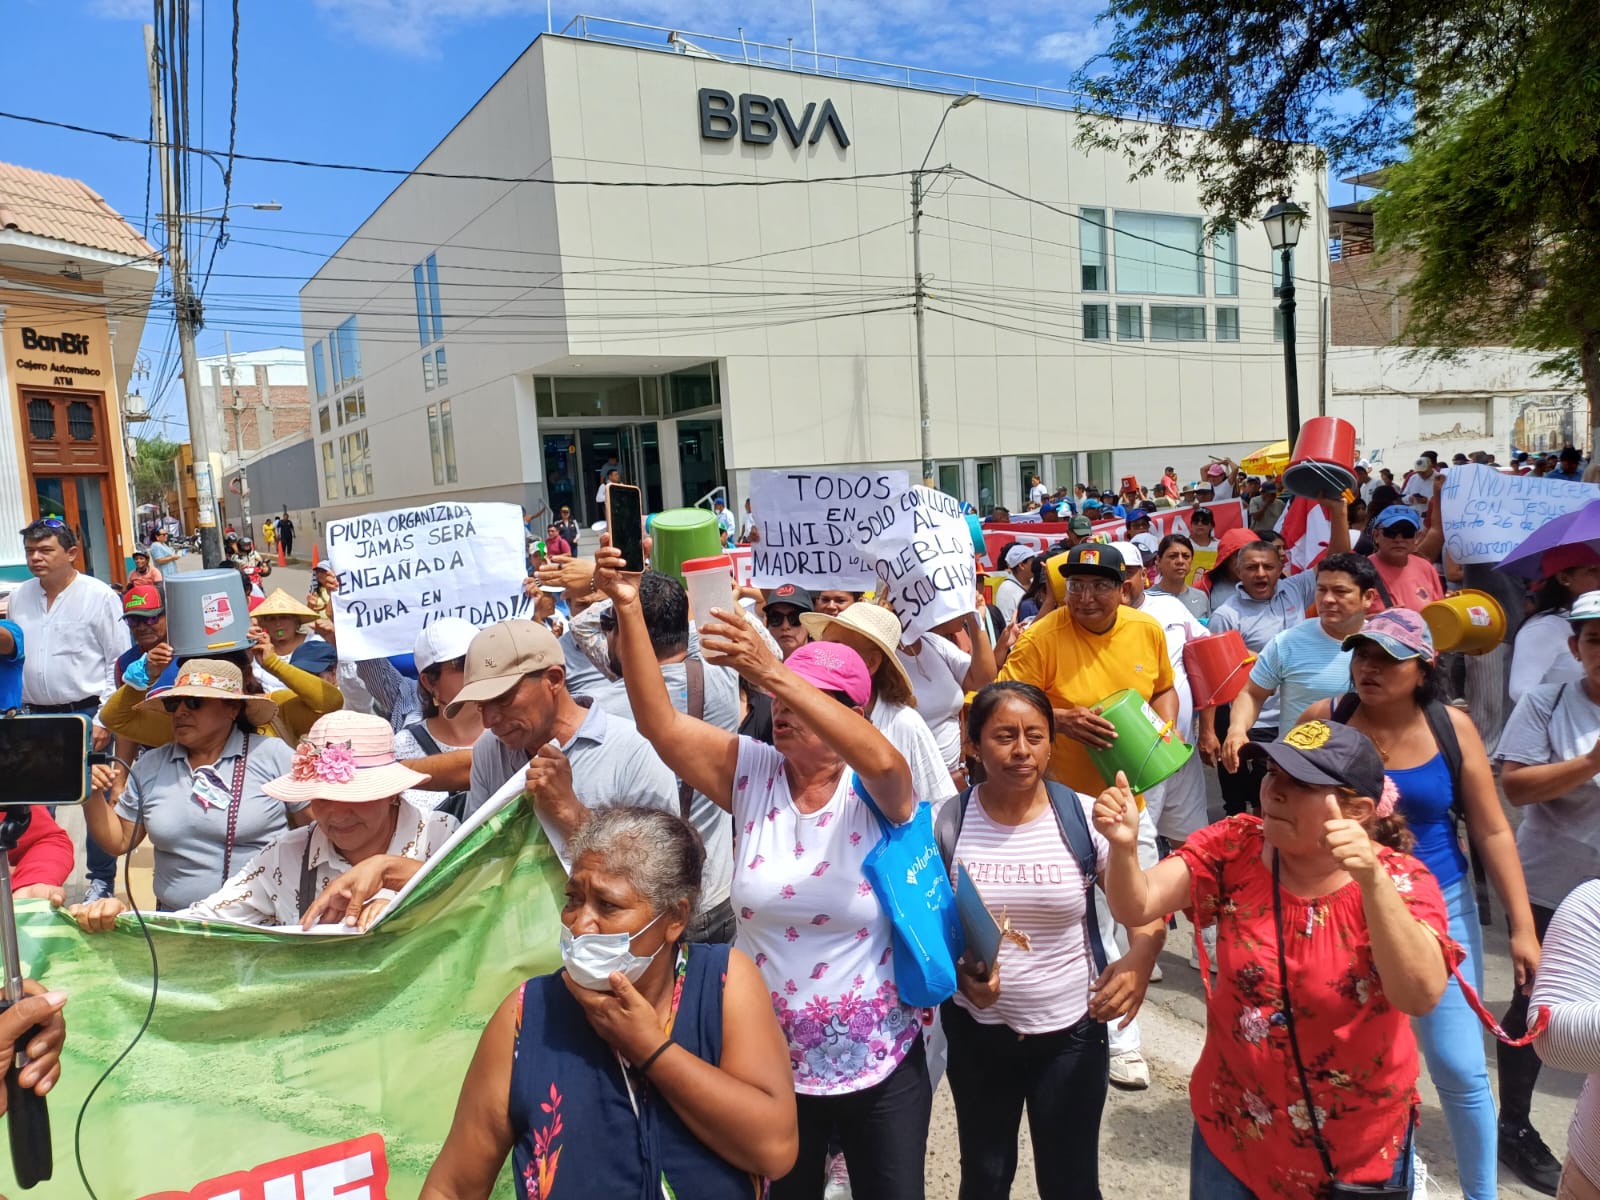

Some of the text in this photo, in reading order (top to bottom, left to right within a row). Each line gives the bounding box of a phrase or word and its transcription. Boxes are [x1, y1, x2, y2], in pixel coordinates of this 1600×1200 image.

[698, 87, 851, 149] BBVA
[21, 326, 90, 355] BanBif
[16, 358, 48, 371] Cajero
[53, 376, 73, 386] ATM
[787, 474, 891, 501] TODOS
[826, 507, 857, 523] EN
[857, 488, 965, 545] SOLO CON LUCHA
[1463, 498, 1567, 516] CON JESUS
[330, 505, 472, 547] PIURA ORGANIZADA
[913, 508, 941, 534] AL
[1447, 534, 1519, 560] Querem
[337, 550, 465, 596] ENGAÑADA
[752, 549, 842, 578] MADRID
[346, 589, 442, 628] PIURA EN
[967, 861, 1062, 885] CHICAGO
